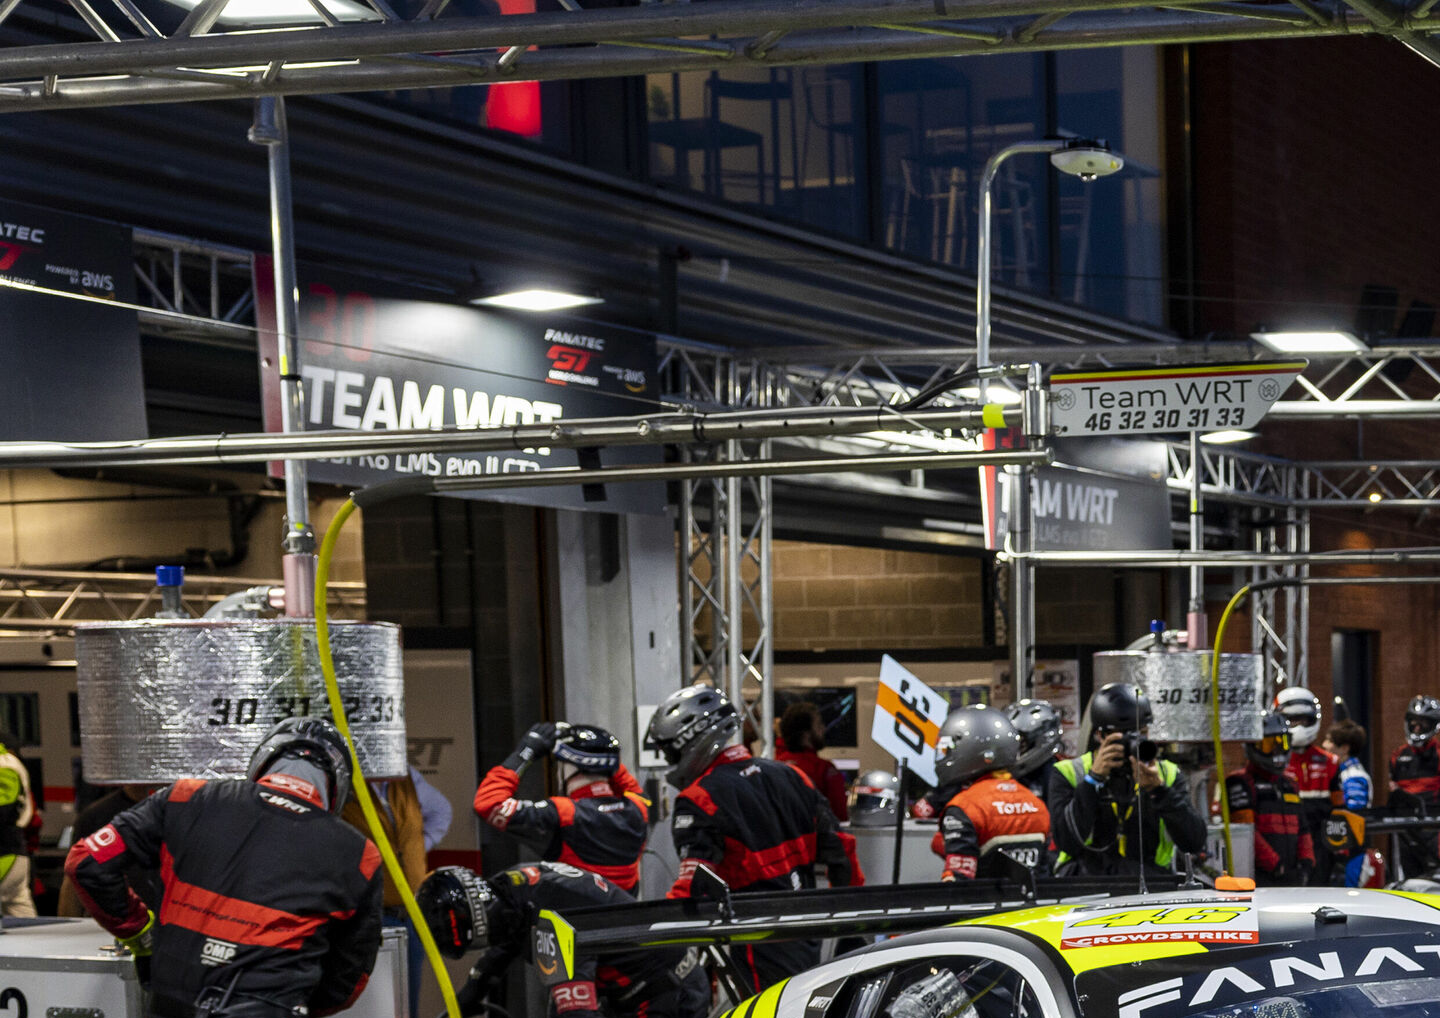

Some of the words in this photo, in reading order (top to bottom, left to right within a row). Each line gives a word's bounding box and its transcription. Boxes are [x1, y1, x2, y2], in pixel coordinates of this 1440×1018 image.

[81, 270, 115, 292] aws
[543, 328, 606, 351] FANATEC
[624, 368, 647, 385] aws
[302, 364, 445, 431] TEAM
[1081, 385, 1167, 411] Team
[1175, 378, 1253, 405] WRT
[1084, 411, 1112, 432] 46
[1118, 409, 1146, 431] 32
[1151, 408, 1181, 430] 30
[1186, 407, 1209, 428] 31
[1215, 406, 1246, 428] 33
[1066, 483, 1119, 527] WRT
[1156, 687, 1183, 705] 30
[1188, 687, 1210, 704] 31
[208, 696, 259, 726] 30
[992, 801, 1039, 816] TOTAL
[1325, 819, 1348, 837] aws
[1068, 906, 1252, 929] 46
[535, 928, 557, 957] aws
[1076, 931, 1254, 947] CROWDSTRIKE
[202, 942, 237, 960] OMP
